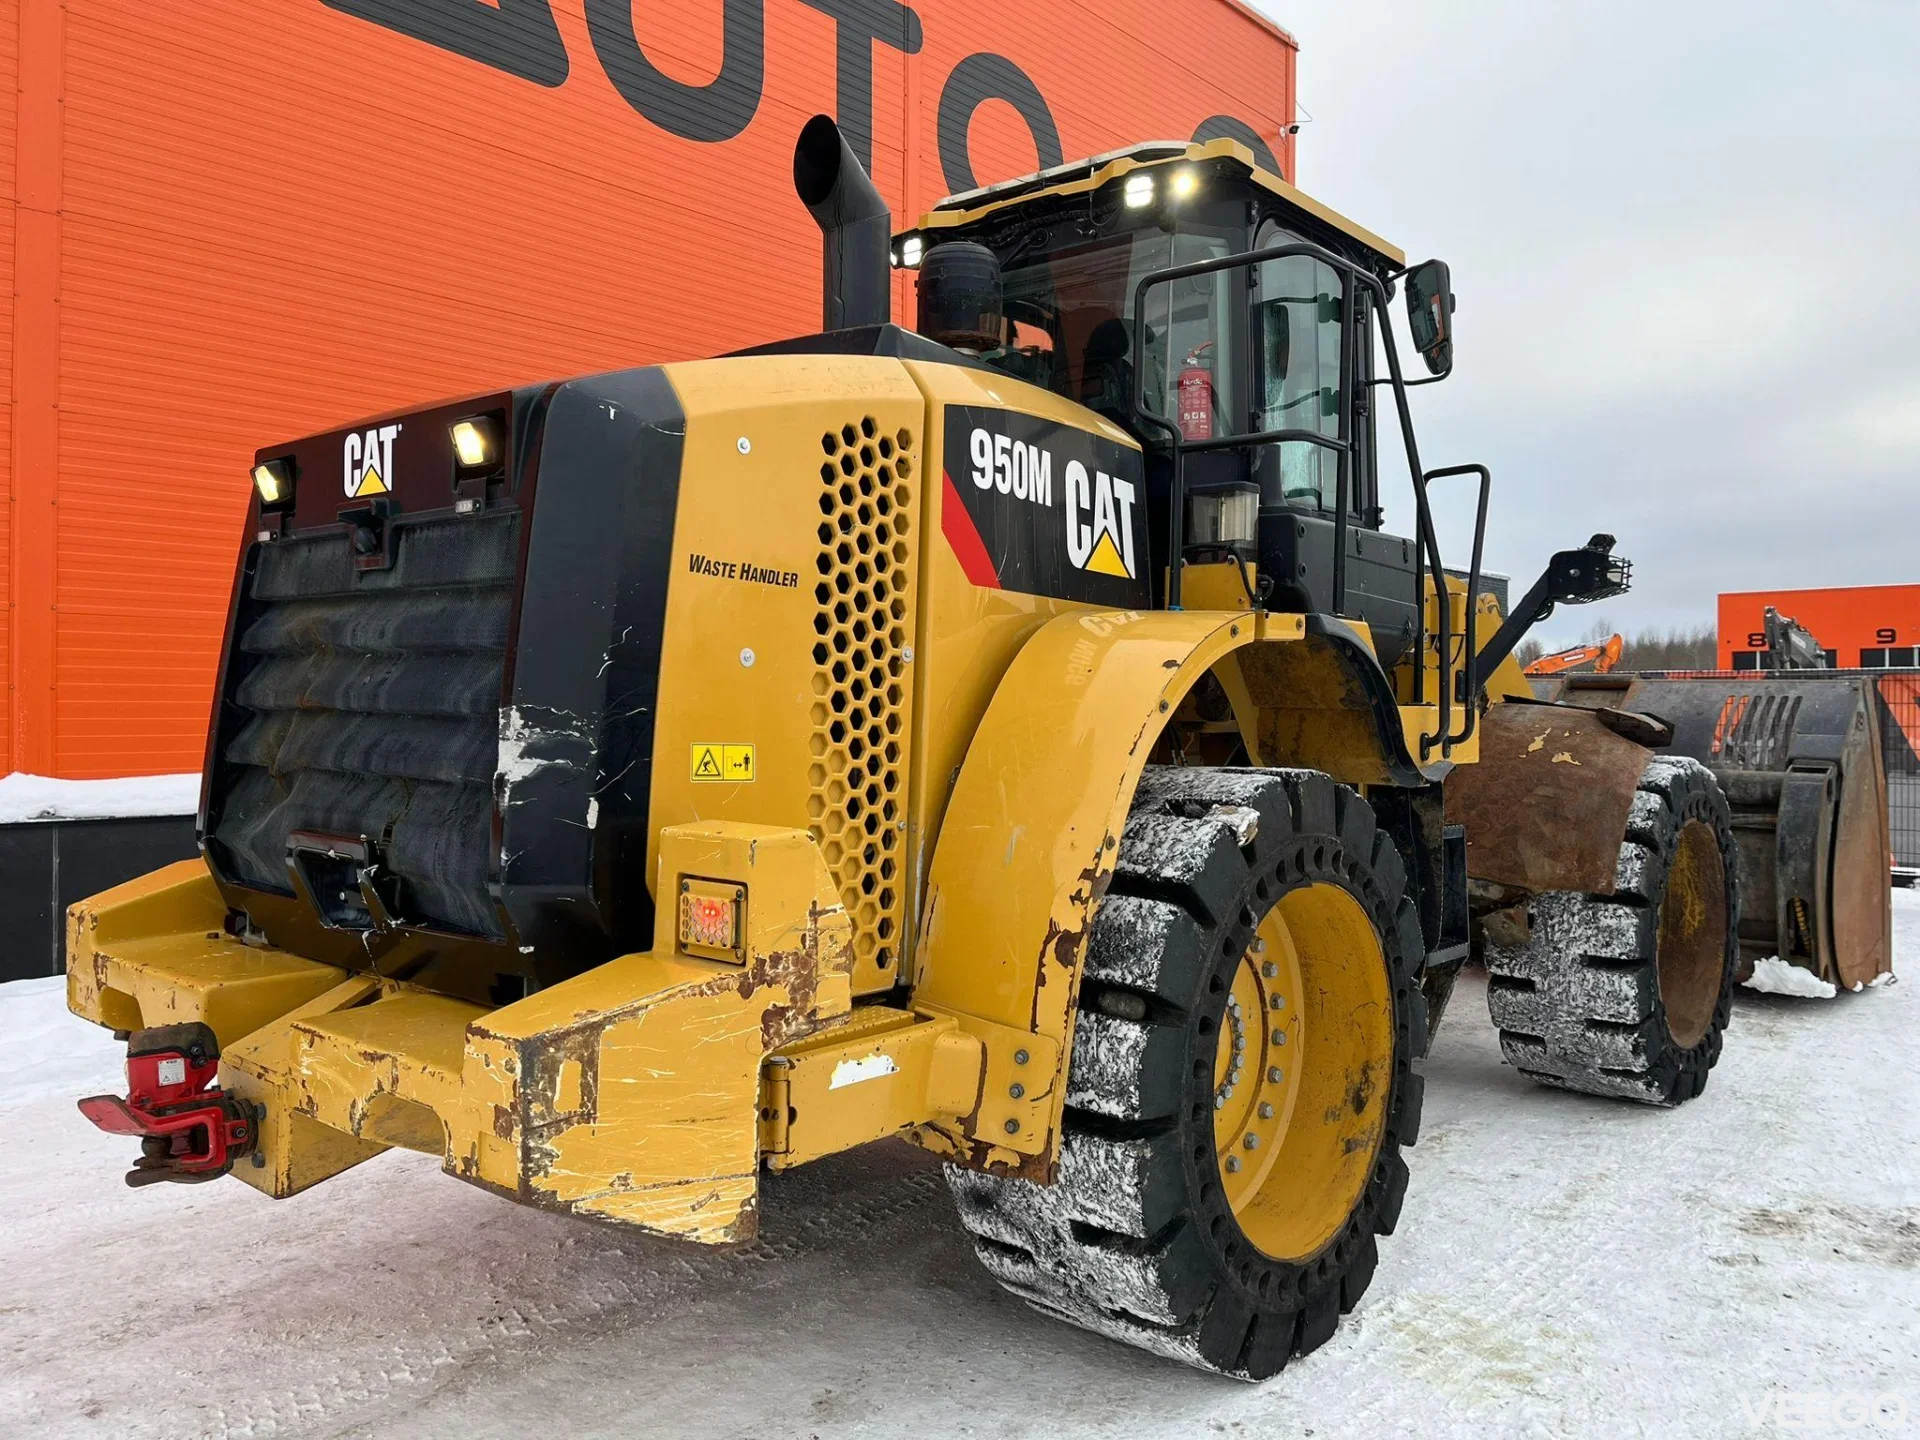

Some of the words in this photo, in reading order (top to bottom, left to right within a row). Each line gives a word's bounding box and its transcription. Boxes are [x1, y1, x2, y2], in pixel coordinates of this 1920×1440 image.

[318, 0, 1064, 197] UTO
[344, 424, 398, 498] CAT
[970, 428, 1052, 507] 950M
[1065, 459, 1136, 580] CAT
[1747, 632, 1767, 648] 8
[1876, 628, 1897, 645] 9
